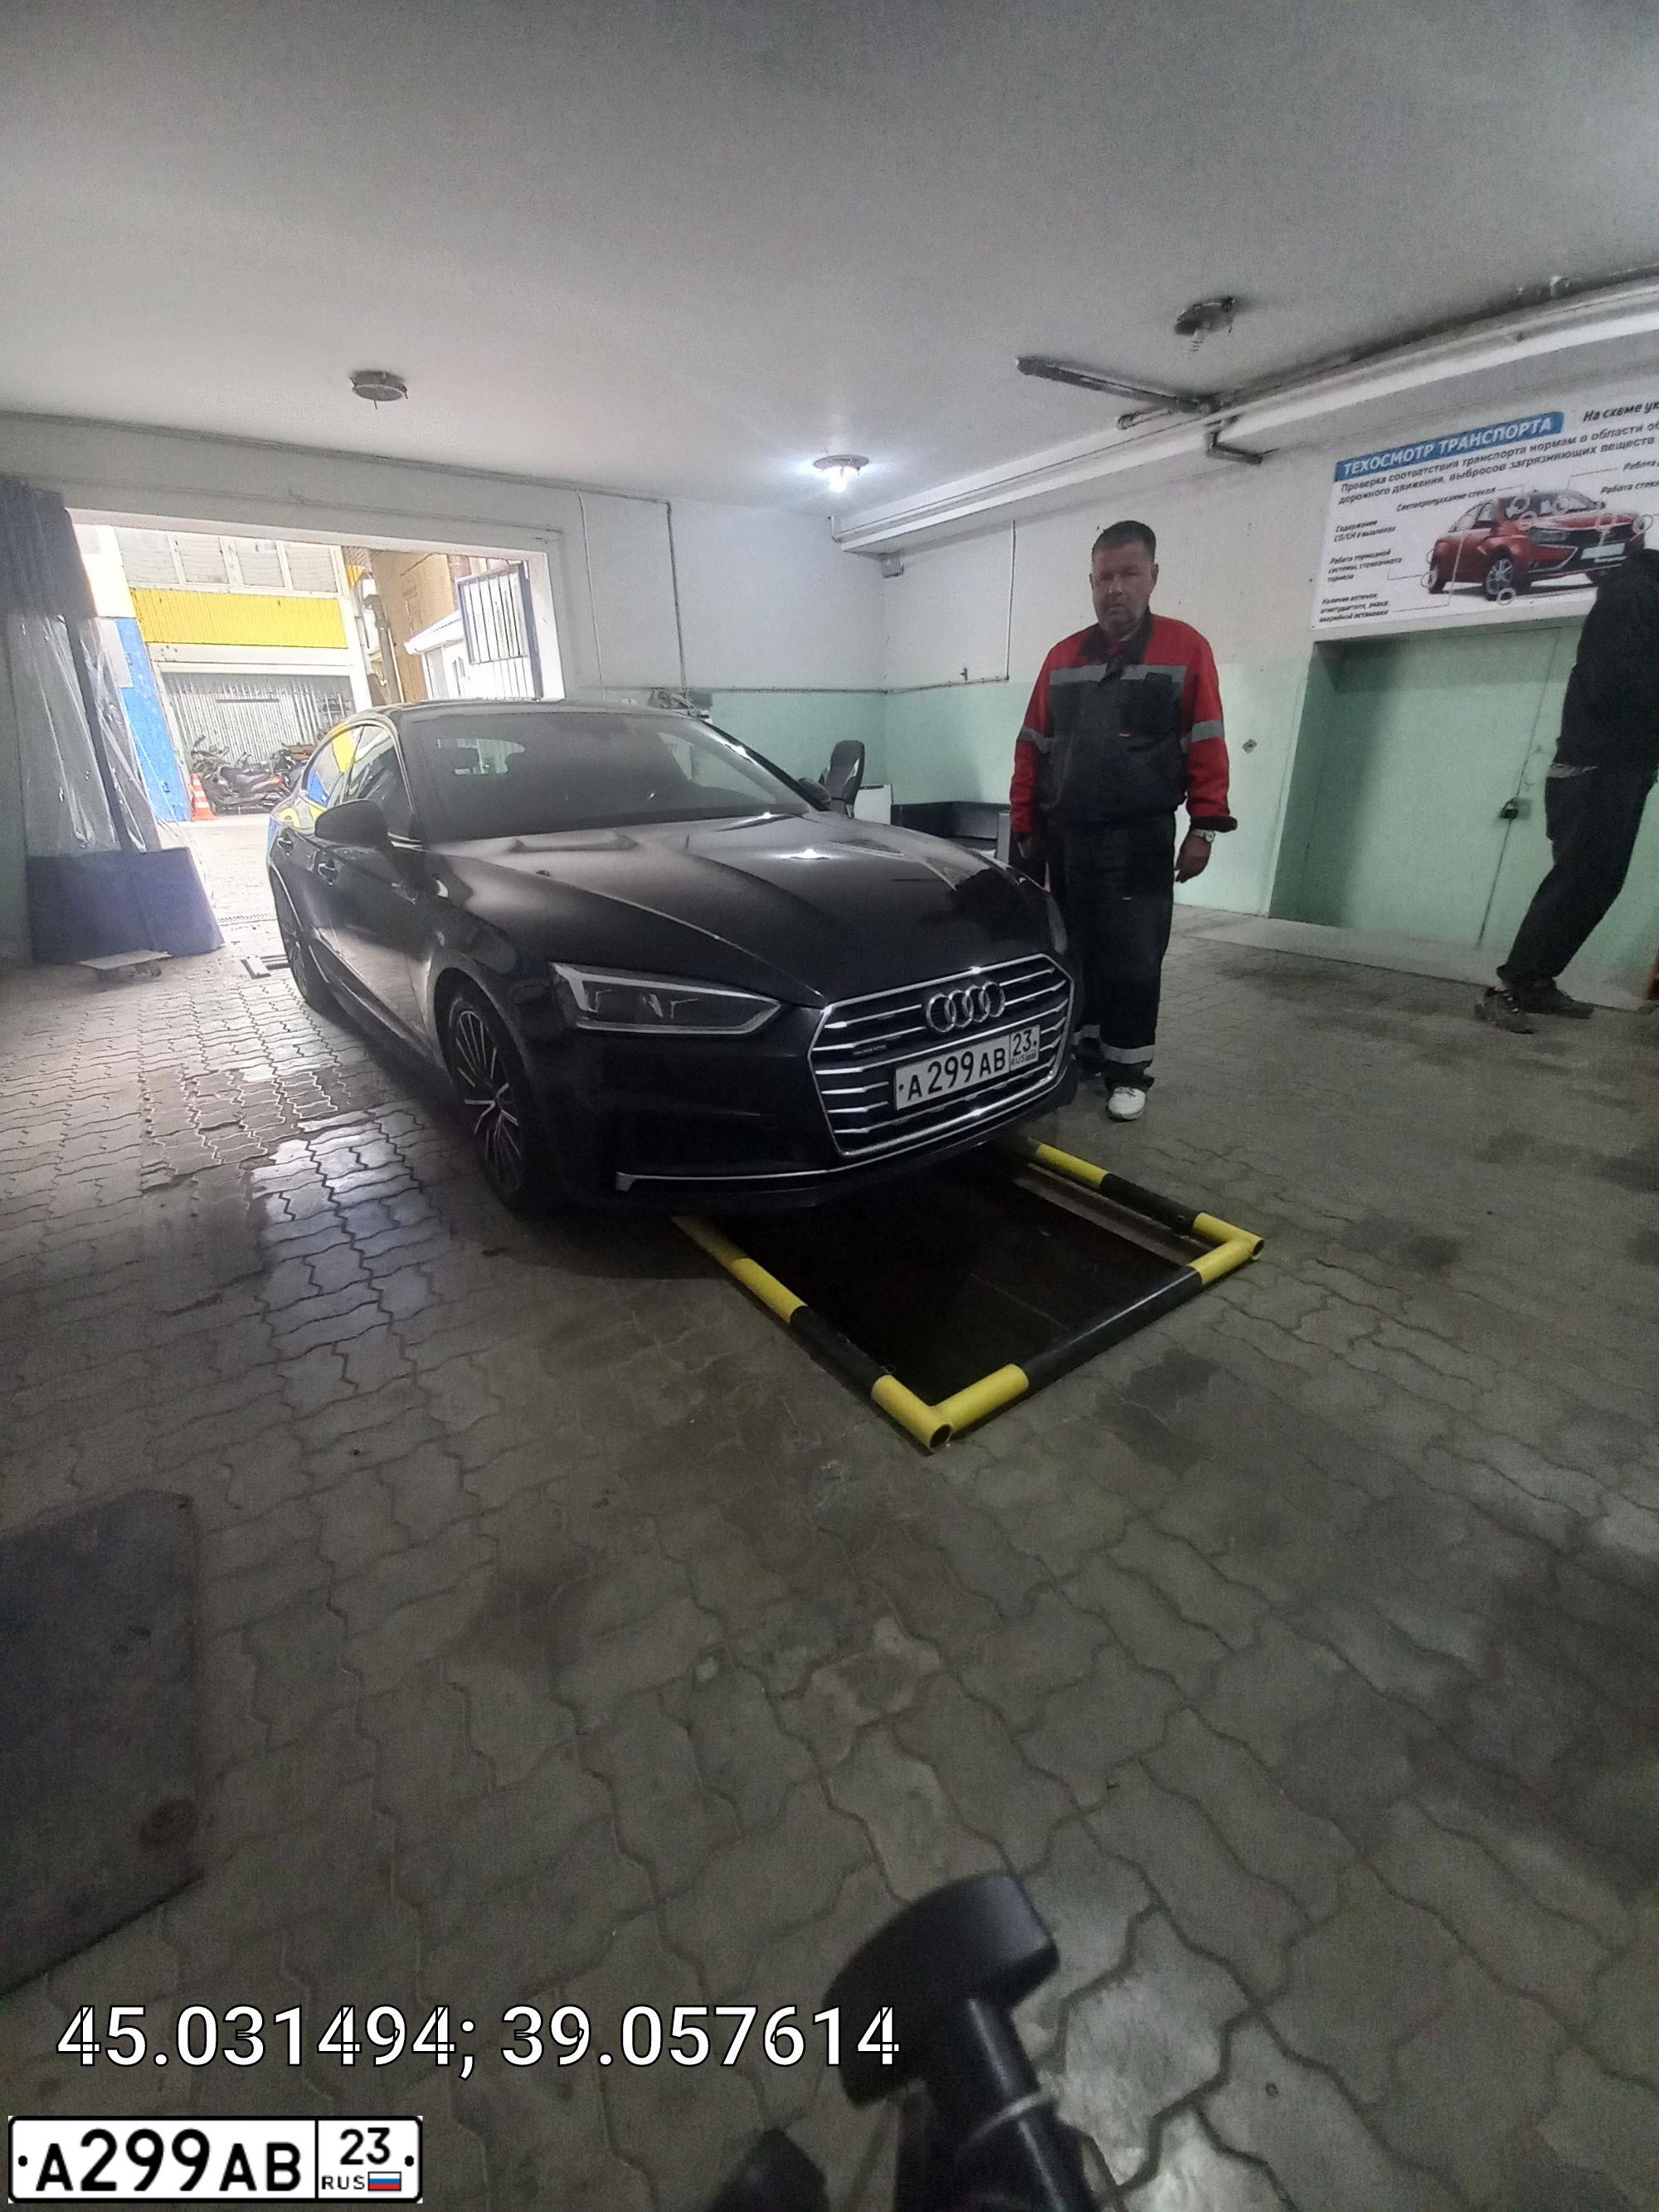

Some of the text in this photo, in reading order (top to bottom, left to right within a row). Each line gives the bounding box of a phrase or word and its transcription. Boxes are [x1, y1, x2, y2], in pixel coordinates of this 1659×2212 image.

[1583, 410, 1600, 422] На
[1603, 403, 1642, 419] схеме
[1340, 475, 1386, 493] Проверка
[1388, 460, 1458, 483] соответствия
[1462, 448, 1526, 469] транспорта
[1530, 436, 1578, 452] нормам
[1579, 435, 1588, 443] в
[1591, 425, 1643, 441] области
[1344, 417, 1552, 476] ТЕХОСМОТР ТРАНСПОРТА
[1623, 460, 1655, 471] Работа
[1338, 489, 1390, 505] дорожного
[1449, 463, 1506, 480] выбросов
[1509, 448, 1597, 470] загрязняющих
[1600, 436, 1655, 453] веществ
[1601, 483, 1634, 495] Работа
[907, 1029, 1033, 1102] А299АВ 23
[1011, 1054, 1025, 1065] RUS
